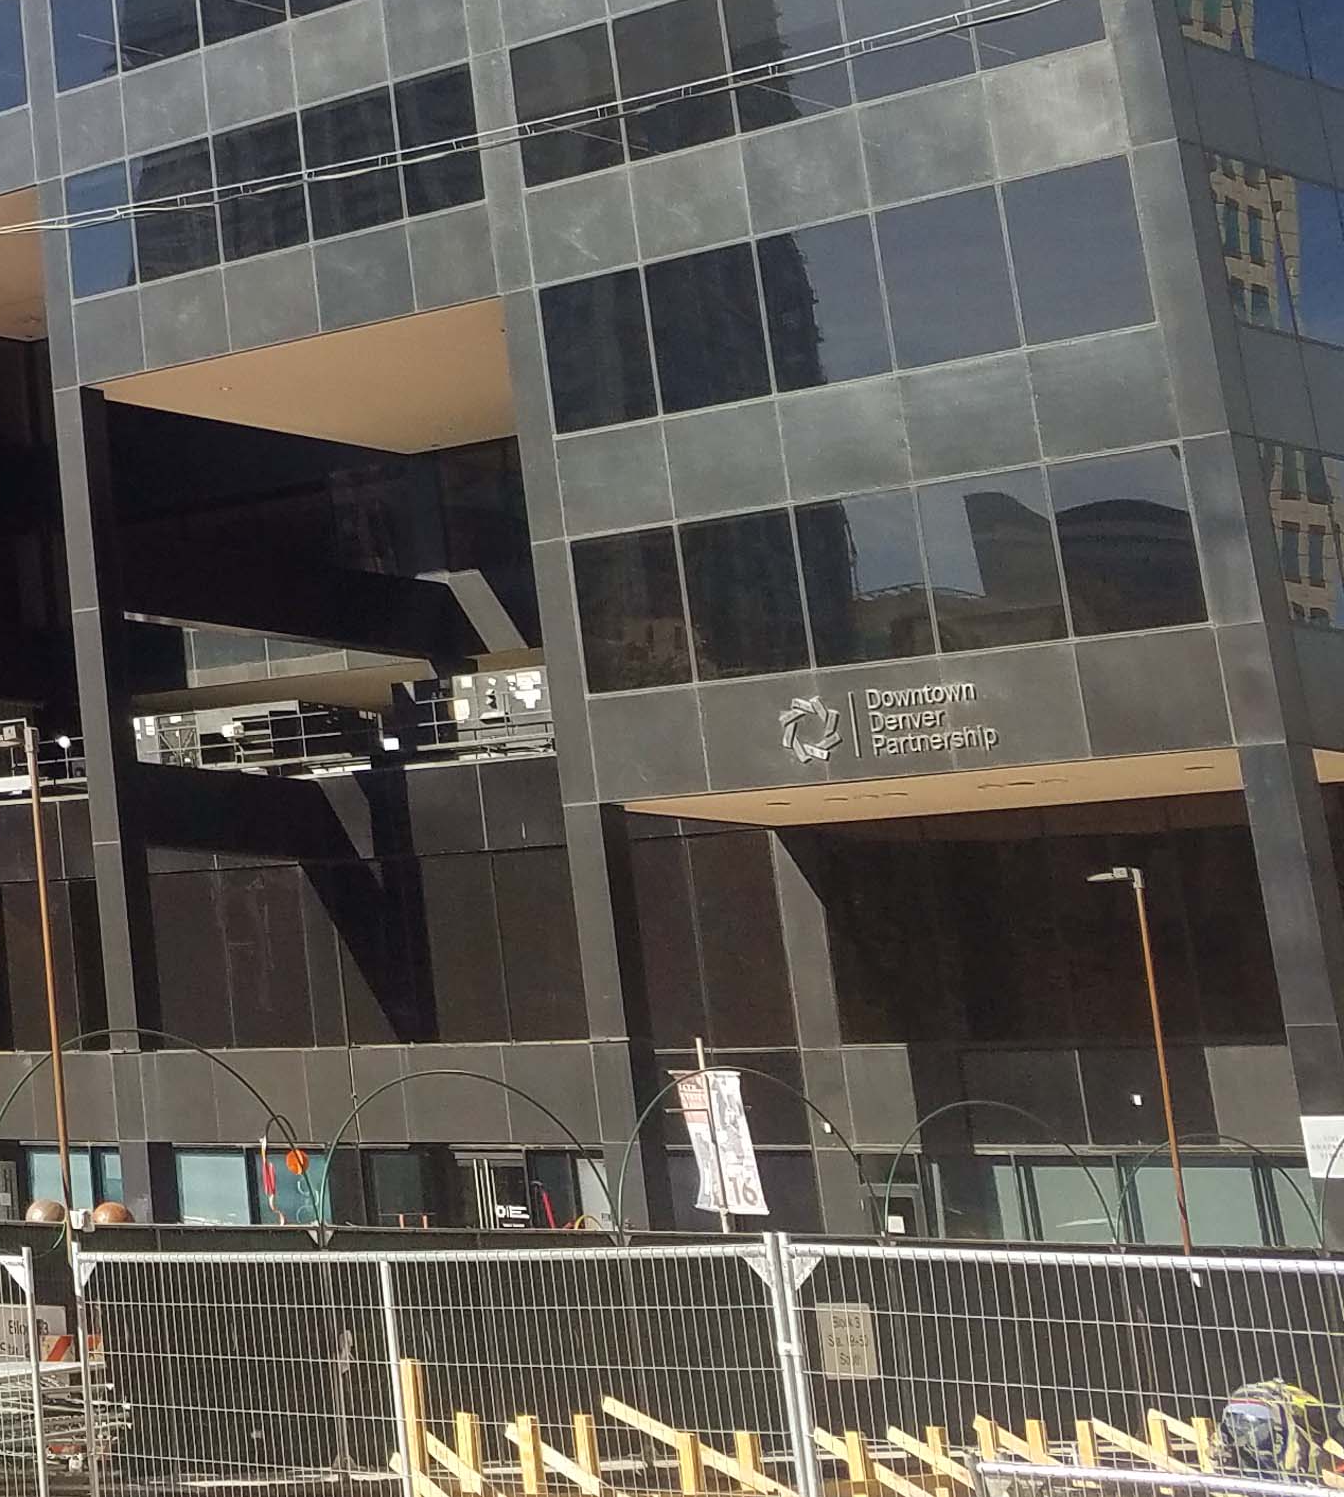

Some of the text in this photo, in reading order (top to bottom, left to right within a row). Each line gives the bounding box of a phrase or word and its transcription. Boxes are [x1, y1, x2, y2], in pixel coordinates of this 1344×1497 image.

[865, 682, 976, 710] Downtown
[868, 708, 945, 733] Denver
[871, 725, 1000, 757] Partnership
[727, 1176, 758, 1206] 16
